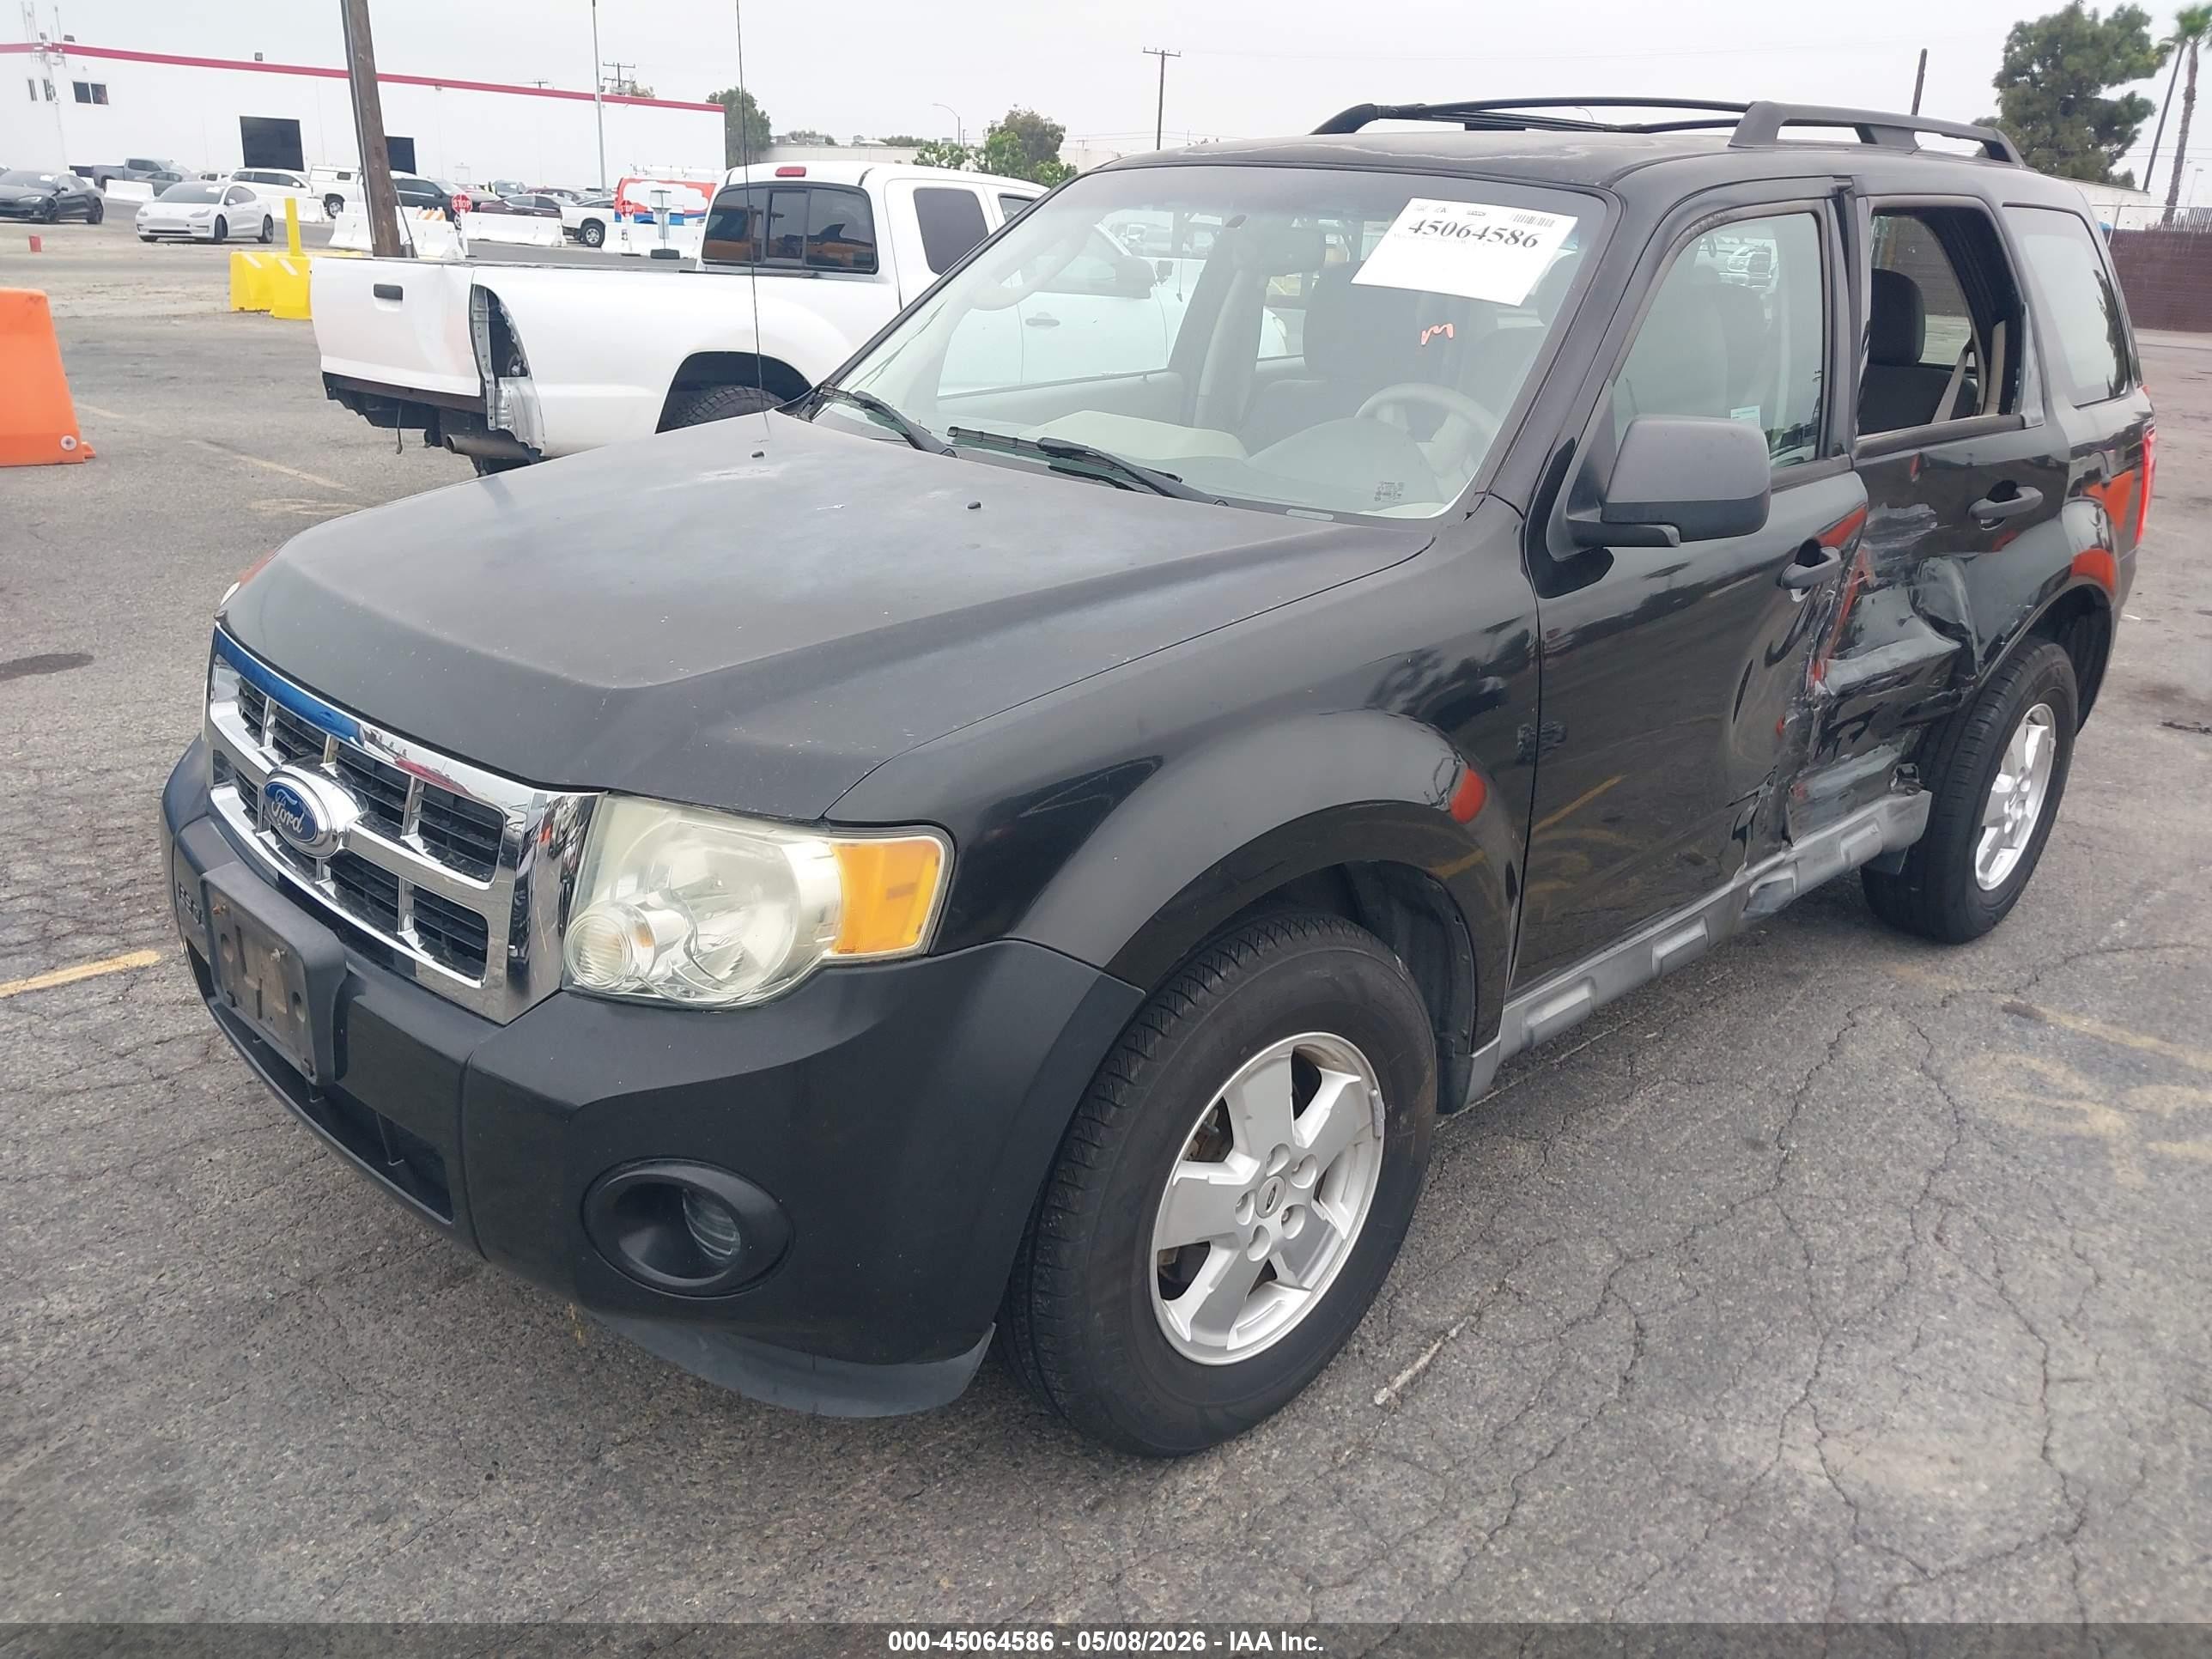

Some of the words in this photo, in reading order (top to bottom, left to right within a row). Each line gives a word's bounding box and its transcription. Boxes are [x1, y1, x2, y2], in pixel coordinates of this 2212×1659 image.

[453, 198, 471, 208] STOP
[1408, 218, 1542, 248] 45064586
[271, 788, 305, 834] Ford
